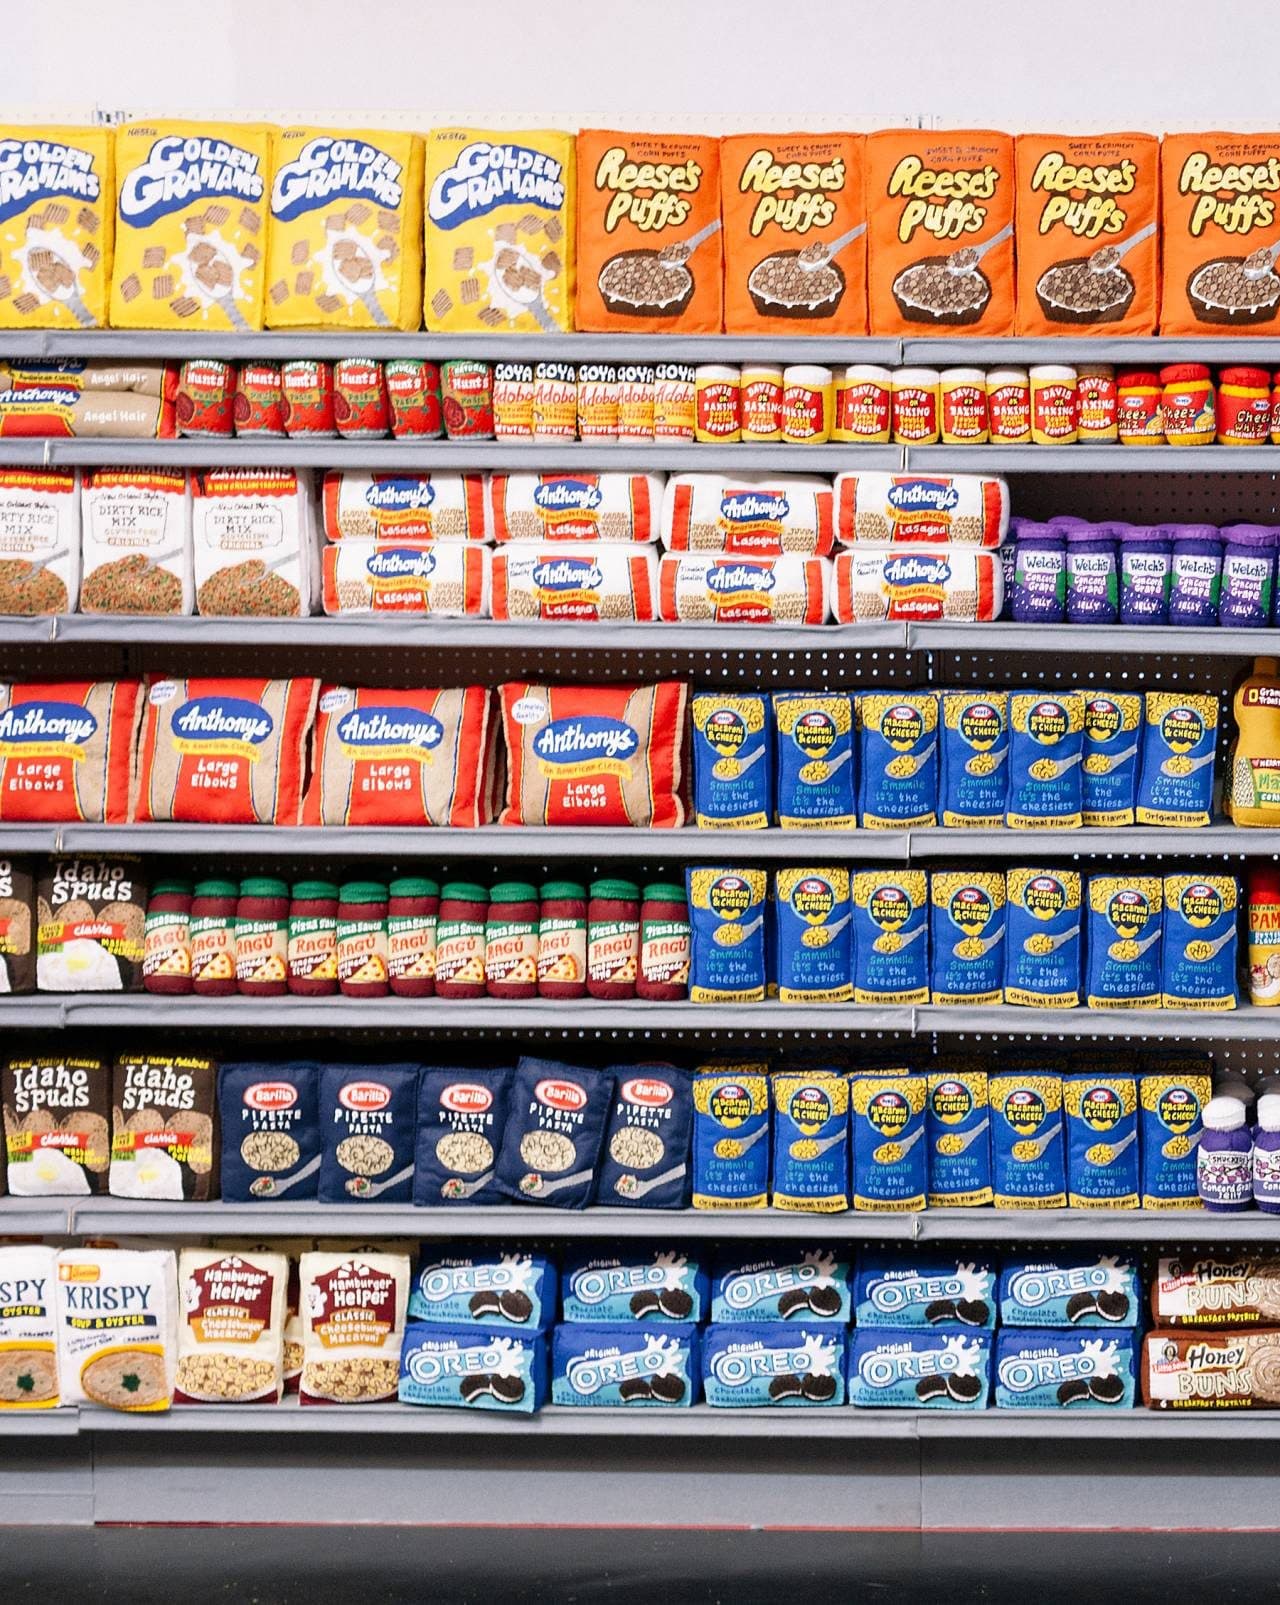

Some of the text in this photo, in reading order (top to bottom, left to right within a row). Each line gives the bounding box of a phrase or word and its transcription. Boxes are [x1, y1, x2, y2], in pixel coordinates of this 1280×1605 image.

[157, 138, 259, 174] GOLDEN
[298, 138, 402, 177] GOLDEN
[457, 143, 562, 180] GOLDEN
[597, 147, 701, 189] Reese's
[741, 151, 845, 193] Reese's
[1033, 152, 1136, 193] Reese's
[889, 156, 998, 198] Reese's
[122, 161, 264, 215] GRAHAMS
[272, 163, 402, 214] GRAHAMS
[430, 167, 564, 220] GRAHAMS
[537, 364, 576, 382] GOYA
[580, 365, 617, 383] GOYA
[853, 387, 881, 399] DAVIS
[952, 388, 980, 400] DAVIS
[84, 409, 147, 424] Angel Hair
[848, 403, 886, 415] BAKING
[950, 405, 985, 416] BAKING
[99, 506, 163, 516] DIRTY RICE
[112, 517, 136, 527] MIX
[549, 524, 594, 536] Lasagna
[380, 525, 426, 536] Lasagna
[898, 525, 945, 537] Lasagna
[732, 535, 780, 547] Lasagna
[1026, 556, 1061, 570] Welch's
[1130, 558, 1165, 571] Welch's
[1232, 562, 1266, 576] Welch's
[198, 760, 239, 775] Large
[370, 764, 411, 778] Large
[191, 775, 237, 789] Elbows
[362, 778, 412, 792] Elbows
[567, 783, 605, 799] Large
[1260, 792, 1280, 802] CORN
[563, 794, 607, 808] Elbows
[706, 801, 758, 812] cheesiest
[878, 801, 928, 813] cheesiest
[53, 861, 125, 882] Idaho
[1250, 913, 1280, 930] PAM
[709, 972, 758, 984] cheesiest
[1103, 980, 1156, 993] cheesiest
[13, 1065, 87, 1095] Idaho
[124, 1065, 193, 1093] Idaho
[334, 1111, 392, 1124] PIPETTE
[617, 1105, 671, 1120] PIPETTE
[349, 1123, 383, 1134] PASTA
[627, 1116, 659, 1128] PASTA
[205, 1269, 266, 1286] Hamburger
[1197, 1261, 1250, 1284] Honey
[330, 1278, 393, 1295] Hamburger
[426, 1267, 511, 1297] OREO
[1019, 1268, 1107, 1300] OREO
[65, 1285, 152, 1311] KRISPY
[210, 1284, 262, 1302] Helper
[335, 1290, 390, 1307] Helper
[1186, 1276, 1264, 1310] BUNS
[71, 1318, 92, 1329] SOUP
[105, 1315, 145, 1328] OYSTER
[727, 1341, 763, 1352] ORIGINAL
[1019, 1346, 1059, 1359] ORIGINAL
[415, 1351, 502, 1380] OREO
[722, 1352, 813, 1380] OREO
[870, 1351, 960, 1381] OREO
[1189, 1346, 1244, 1370] Honey
[575, 1352, 663, 1388] OREO
[1009, 1356, 1096, 1387] OREO
[1178, 1371, 1252, 1398] BUNS
